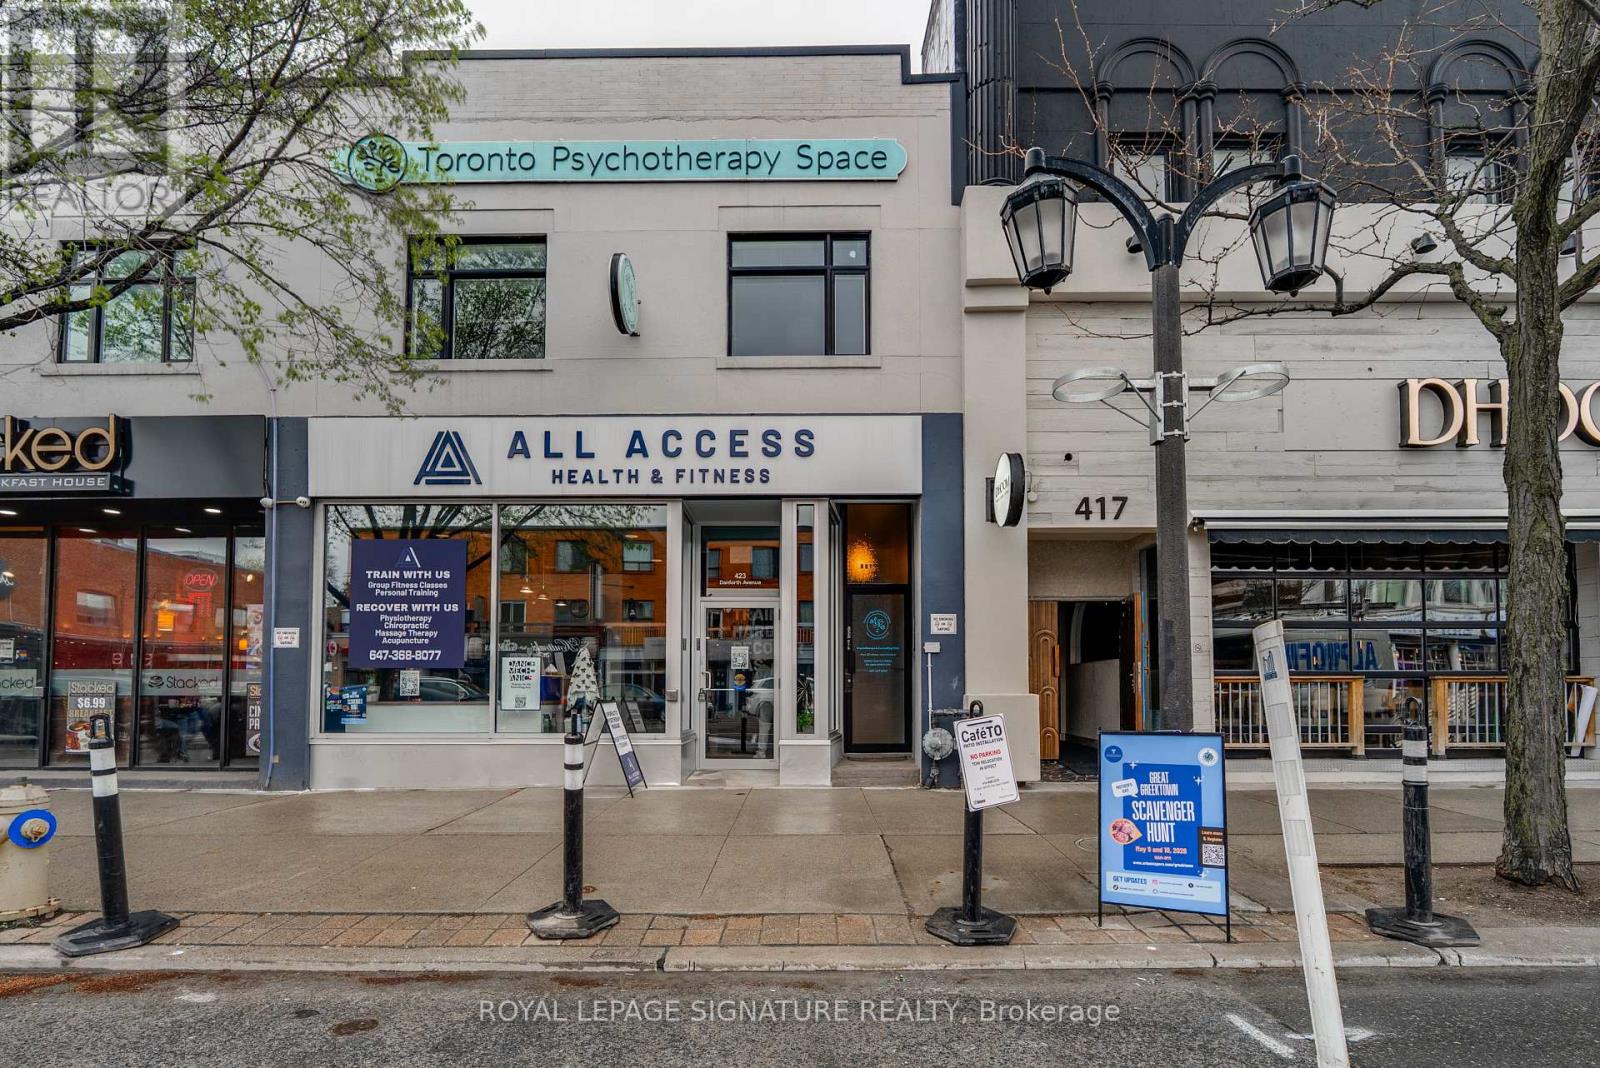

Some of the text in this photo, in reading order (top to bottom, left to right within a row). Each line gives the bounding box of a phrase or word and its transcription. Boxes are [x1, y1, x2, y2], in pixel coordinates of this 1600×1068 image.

[418, 144, 888, 176] Toronto Psychotherapy Space
[506, 429, 816, 459] ALL ACCESS
[52, 477, 106, 487] HOUSE
[552, 467, 771, 485] HEALTH & FITNESS
[1075, 496, 1129, 520] 417
[185, 574, 215, 587] OPEN
[366, 570, 450, 579] TRAIN WITH US
[368, 581, 448, 590] Group Fitness Classes
[408, 589, 439, 598] Training
[356, 603, 459, 612] RECOVER WITH US
[380, 614, 432, 623] Physiotherapy
[384, 622, 430, 630] Chiropractic
[375, 629, 438, 638] Massage Therapy
[382, 637, 430, 645] Acupuncture
[369, 650, 442, 661] 647-368-8077
[71, 681, 114, 693] Stacked
[166, 674, 218, 689] Stacked
[77, 697, 106, 709] $6.99
[961, 724, 1003, 743] CaféTO
[970, 749, 1002, 761] NO PARKING
[1149, 771, 1169, 784] GREAT
[1140, 783, 1179, 796] GREEKTOWN
[1131, 800, 1196, 822] SCAVENGER
[1146, 822, 1176, 843] HUNT
[1124, 877, 1148, 885] UPDATES
